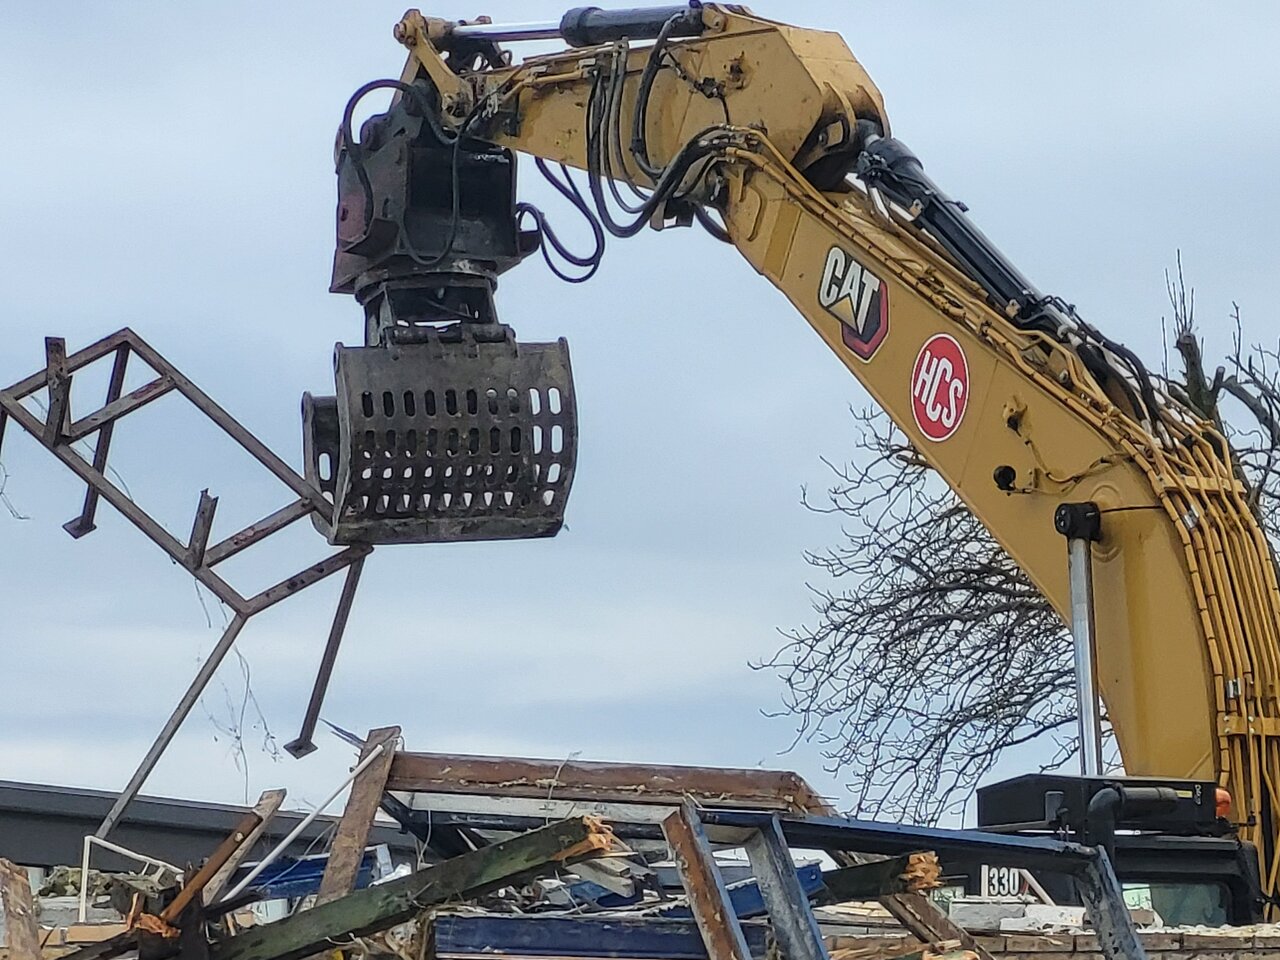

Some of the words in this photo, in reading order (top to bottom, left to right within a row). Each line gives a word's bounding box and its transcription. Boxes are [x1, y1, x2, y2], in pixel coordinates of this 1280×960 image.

[820, 247, 879, 335] CAT
[914, 350, 963, 428] HCS
[989, 867, 1020, 895] 330
